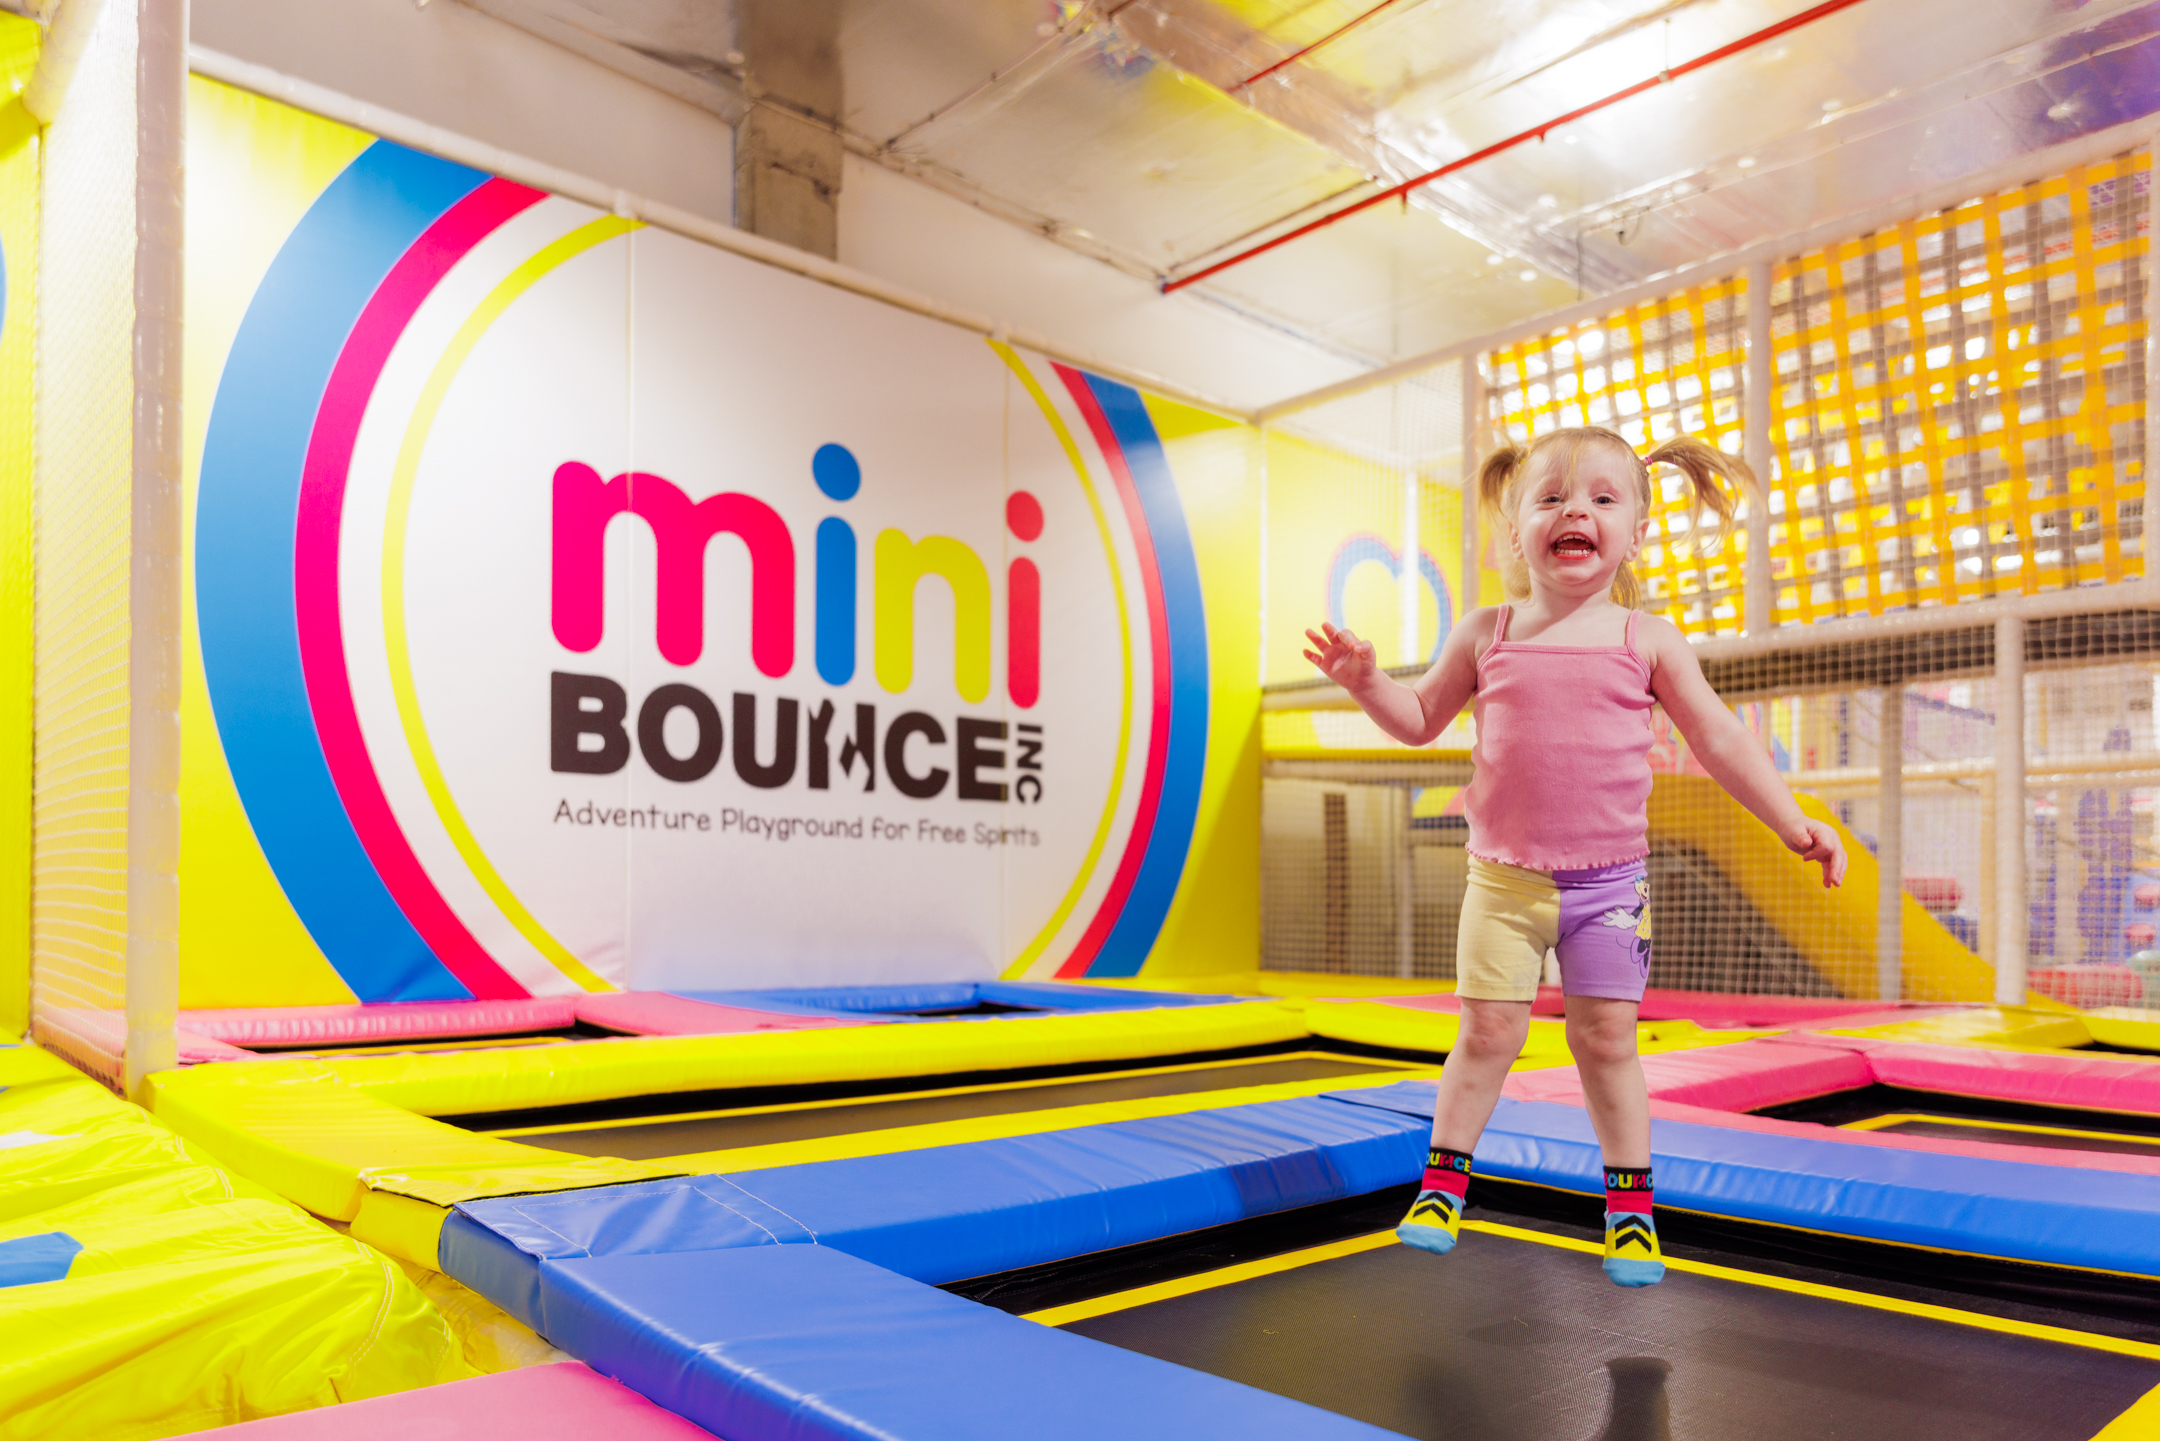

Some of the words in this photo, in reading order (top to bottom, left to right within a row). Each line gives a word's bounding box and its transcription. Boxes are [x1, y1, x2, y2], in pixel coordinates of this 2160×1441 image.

[551, 443, 1044, 709] mini
[550, 670, 1009, 803] BOUNCE
[1016, 722, 1043, 804] INC
[553, 798, 711, 832] Adventure
[721, 807, 863, 842] Playground
[872, 816, 910, 840] for
[918, 819, 966, 844] Free
[974, 822, 1040, 849] Spirits
[1426, 1151, 1471, 1173] OUNCE
